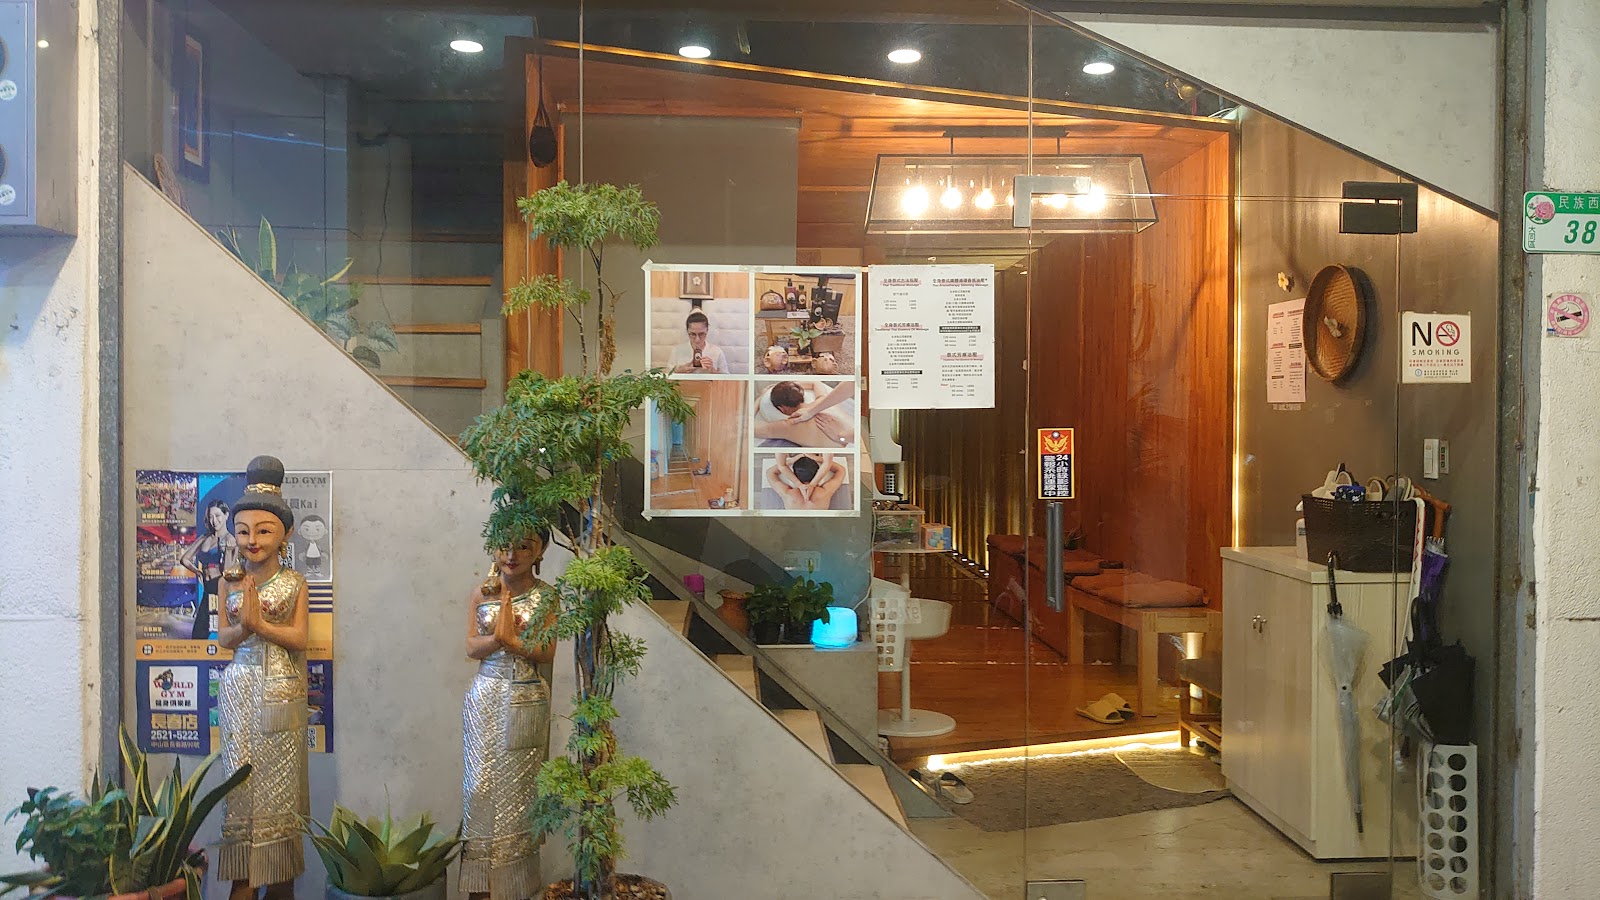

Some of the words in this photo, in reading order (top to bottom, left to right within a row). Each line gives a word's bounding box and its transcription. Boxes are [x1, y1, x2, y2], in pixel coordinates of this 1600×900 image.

[1558, 195, 1599, 209] 民族西
[1564, 219, 1597, 244] 38
[302, 476, 327, 484] GYM
[151, 730, 199, 741] 2521-5222
